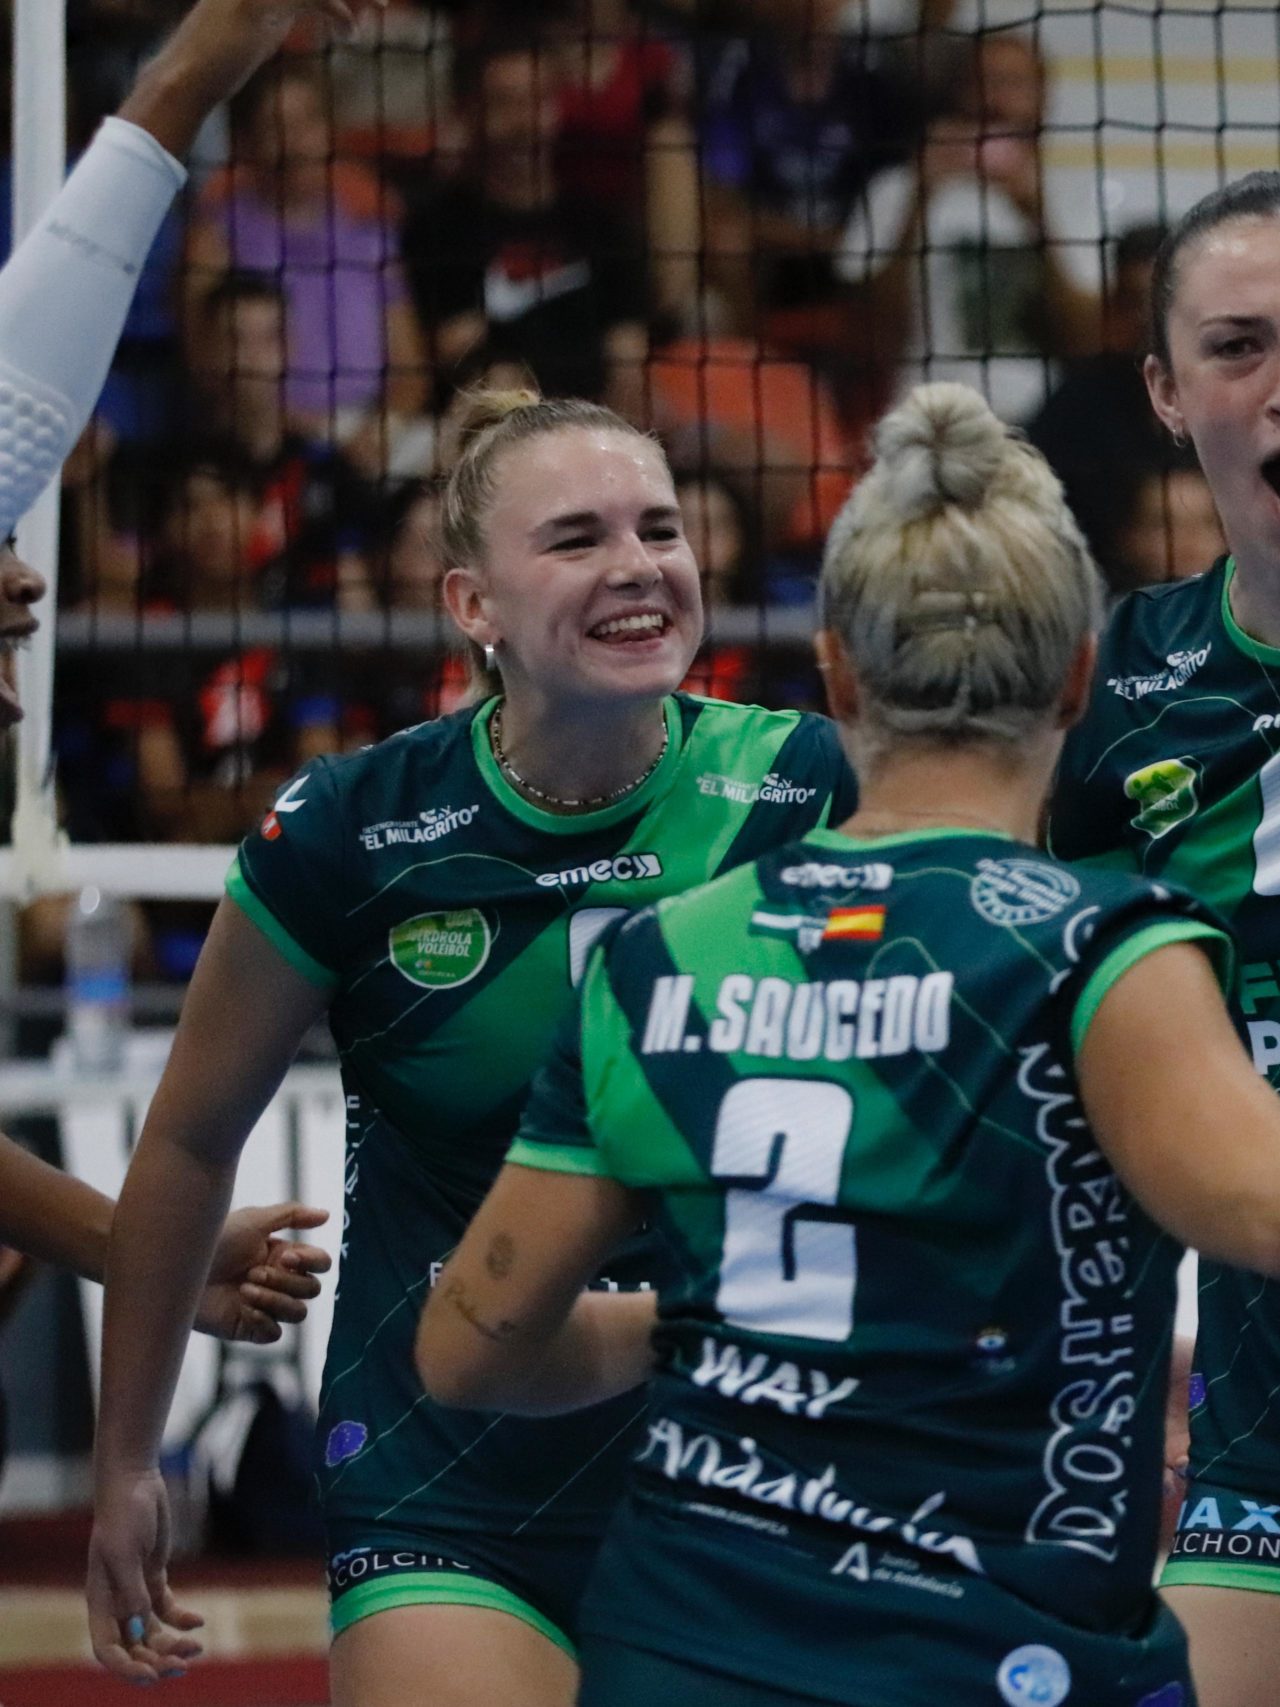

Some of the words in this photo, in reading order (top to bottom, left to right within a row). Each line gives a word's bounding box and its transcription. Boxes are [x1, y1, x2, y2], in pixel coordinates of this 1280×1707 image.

[535, 856, 633, 887] emec
[641, 974, 702, 1055] M.
[708, 971, 954, 1062] SAUCEDO
[711, 1078, 858, 1341] 2
[692, 1337, 862, 1420] WAY
[1172, 1532, 1280, 1558] LCHON
